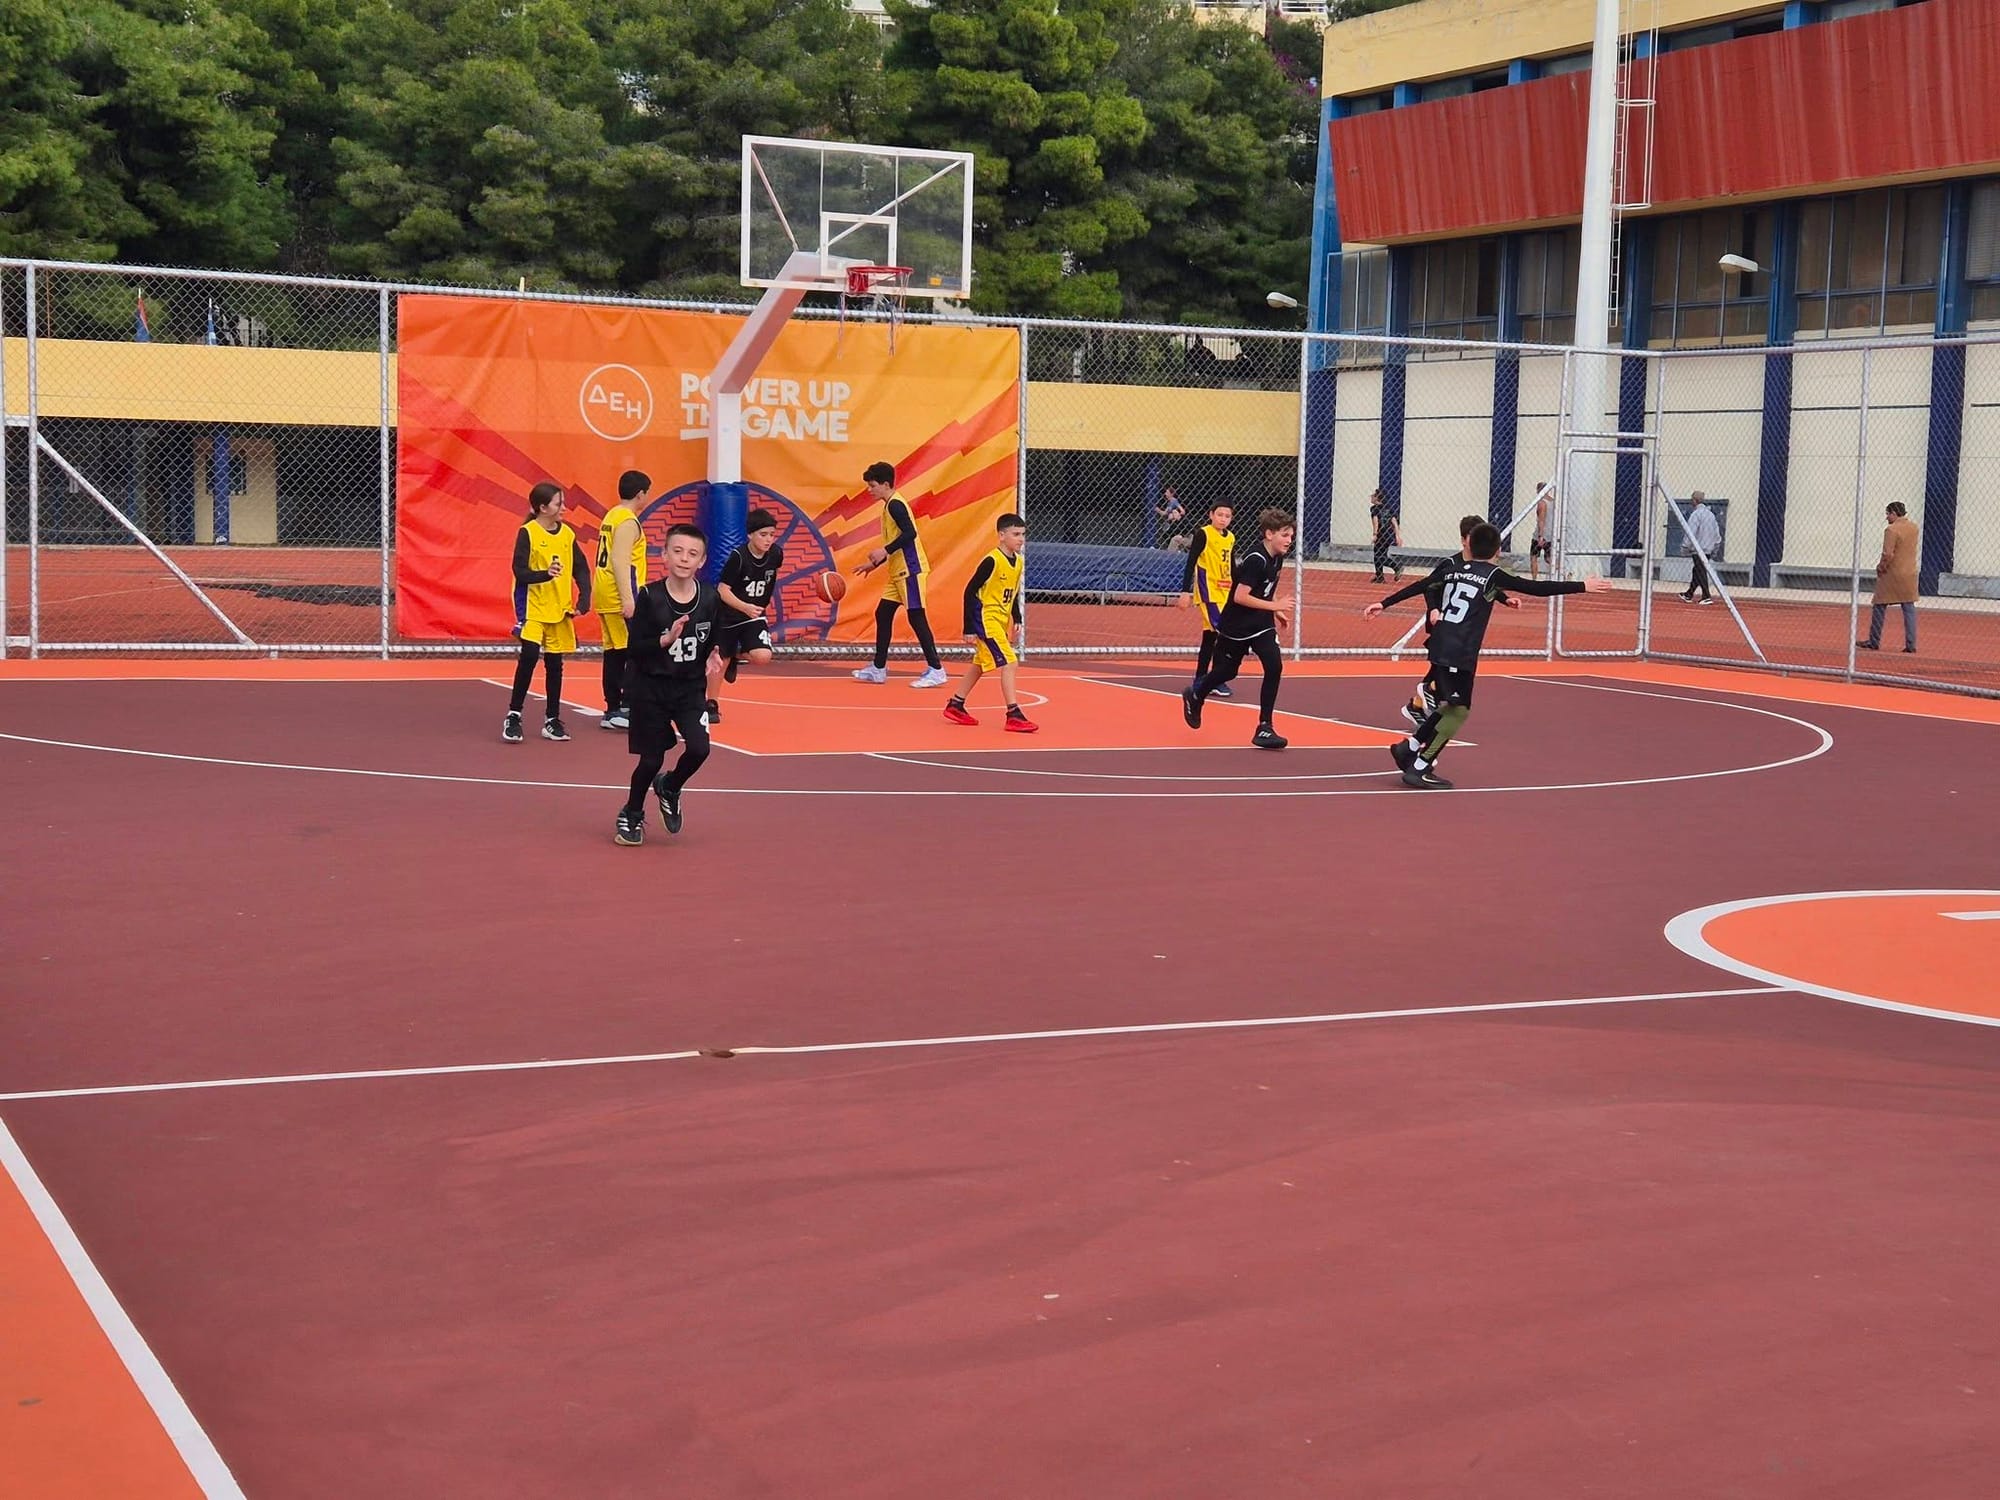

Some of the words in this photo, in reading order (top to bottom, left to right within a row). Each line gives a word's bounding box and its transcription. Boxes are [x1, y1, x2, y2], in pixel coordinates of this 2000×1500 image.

[587, 384, 642, 420] ΔΕΗ
[808, 380, 850, 409] UP
[740, 406, 849, 442] GAME
[745, 580, 766, 597] 46
[668, 636, 698, 662] 43
